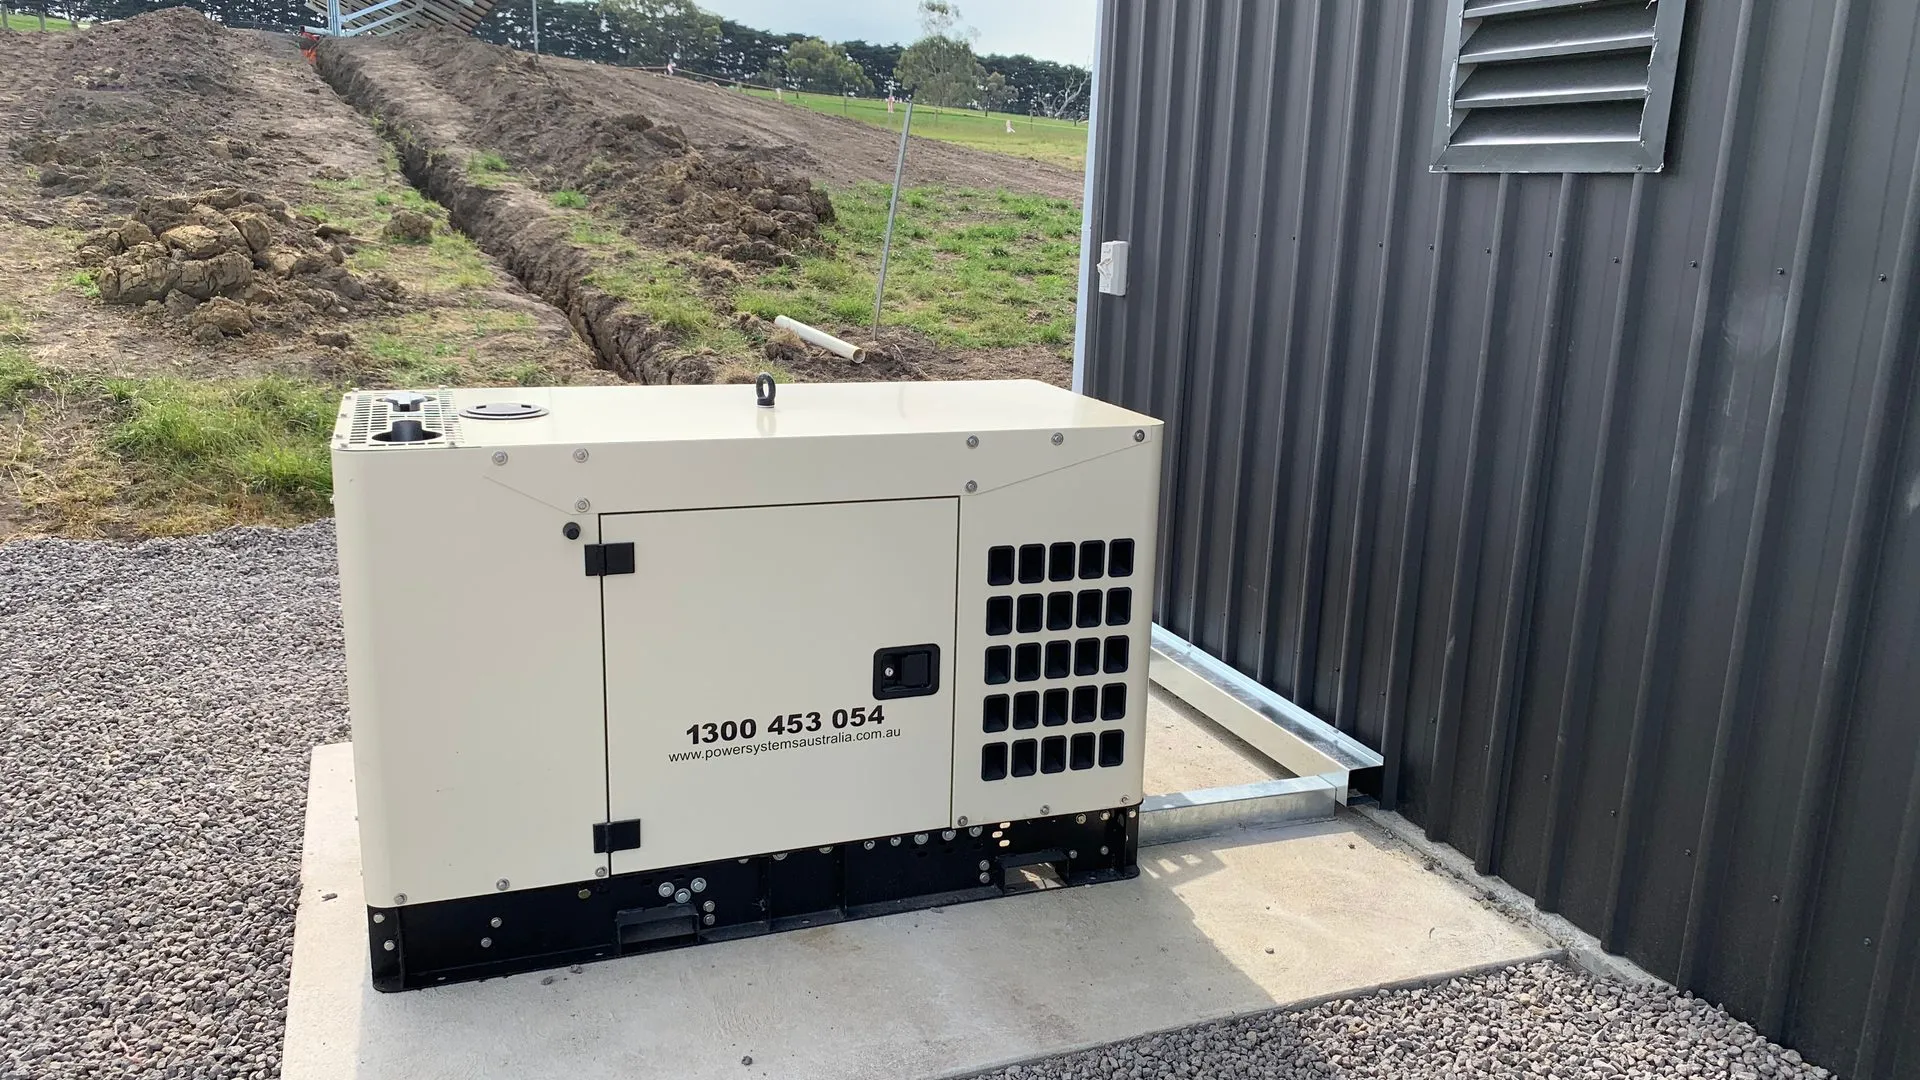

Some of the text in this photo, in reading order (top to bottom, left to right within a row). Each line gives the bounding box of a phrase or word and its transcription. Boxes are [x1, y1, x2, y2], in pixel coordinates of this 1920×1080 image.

[686, 705, 885, 745] 1300 453 054
[668, 727, 901, 762] www.powersystemsaustralia.com.au
